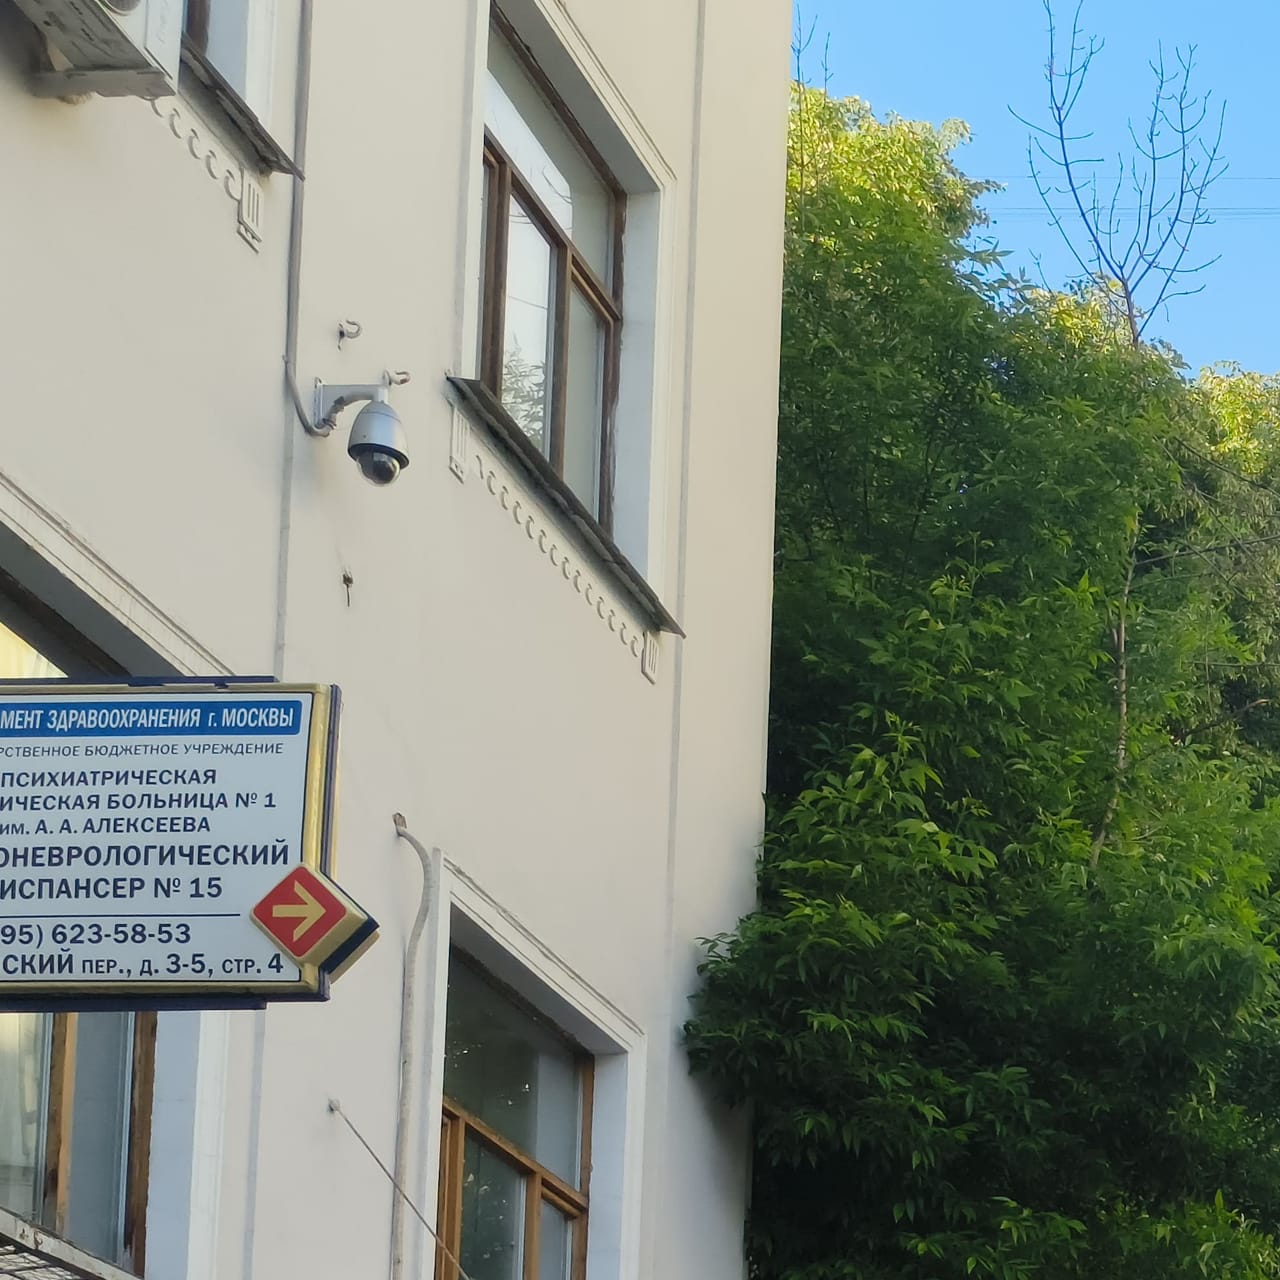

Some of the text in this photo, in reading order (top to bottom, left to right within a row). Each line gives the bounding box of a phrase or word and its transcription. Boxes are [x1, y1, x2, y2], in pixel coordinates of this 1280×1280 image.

[0, 707, 294, 732] МЕНТ ЗДРАВООХРАНЕНИЯ г. МОСКВЫ
[85, 743, 179, 757] БЮДЖЕТНОЕ
[184, 742, 284, 755] УЧРЕЖДЕНИЕ
[1, 769, 217, 787] ПСИХИАТРИЧЕСКАЯ
[0, 792, 276, 811] ИЧЕСКАЯ БОЛЬНИЦА № 1
[35, 819, 54, 834] А.
[59, 819, 78, 834] А.
[83, 816, 210, 833] АЛЕКСЕЕВА
[0, 876, 222, 900] ИСПАНСЕР № 15
[0, 923, 191, 949] 95) 623-58-53
[2, 947, 73, 975] СКИЙ
[166, 953, 213, 978] 3-5,
[268, 953, 284, 974] 4
